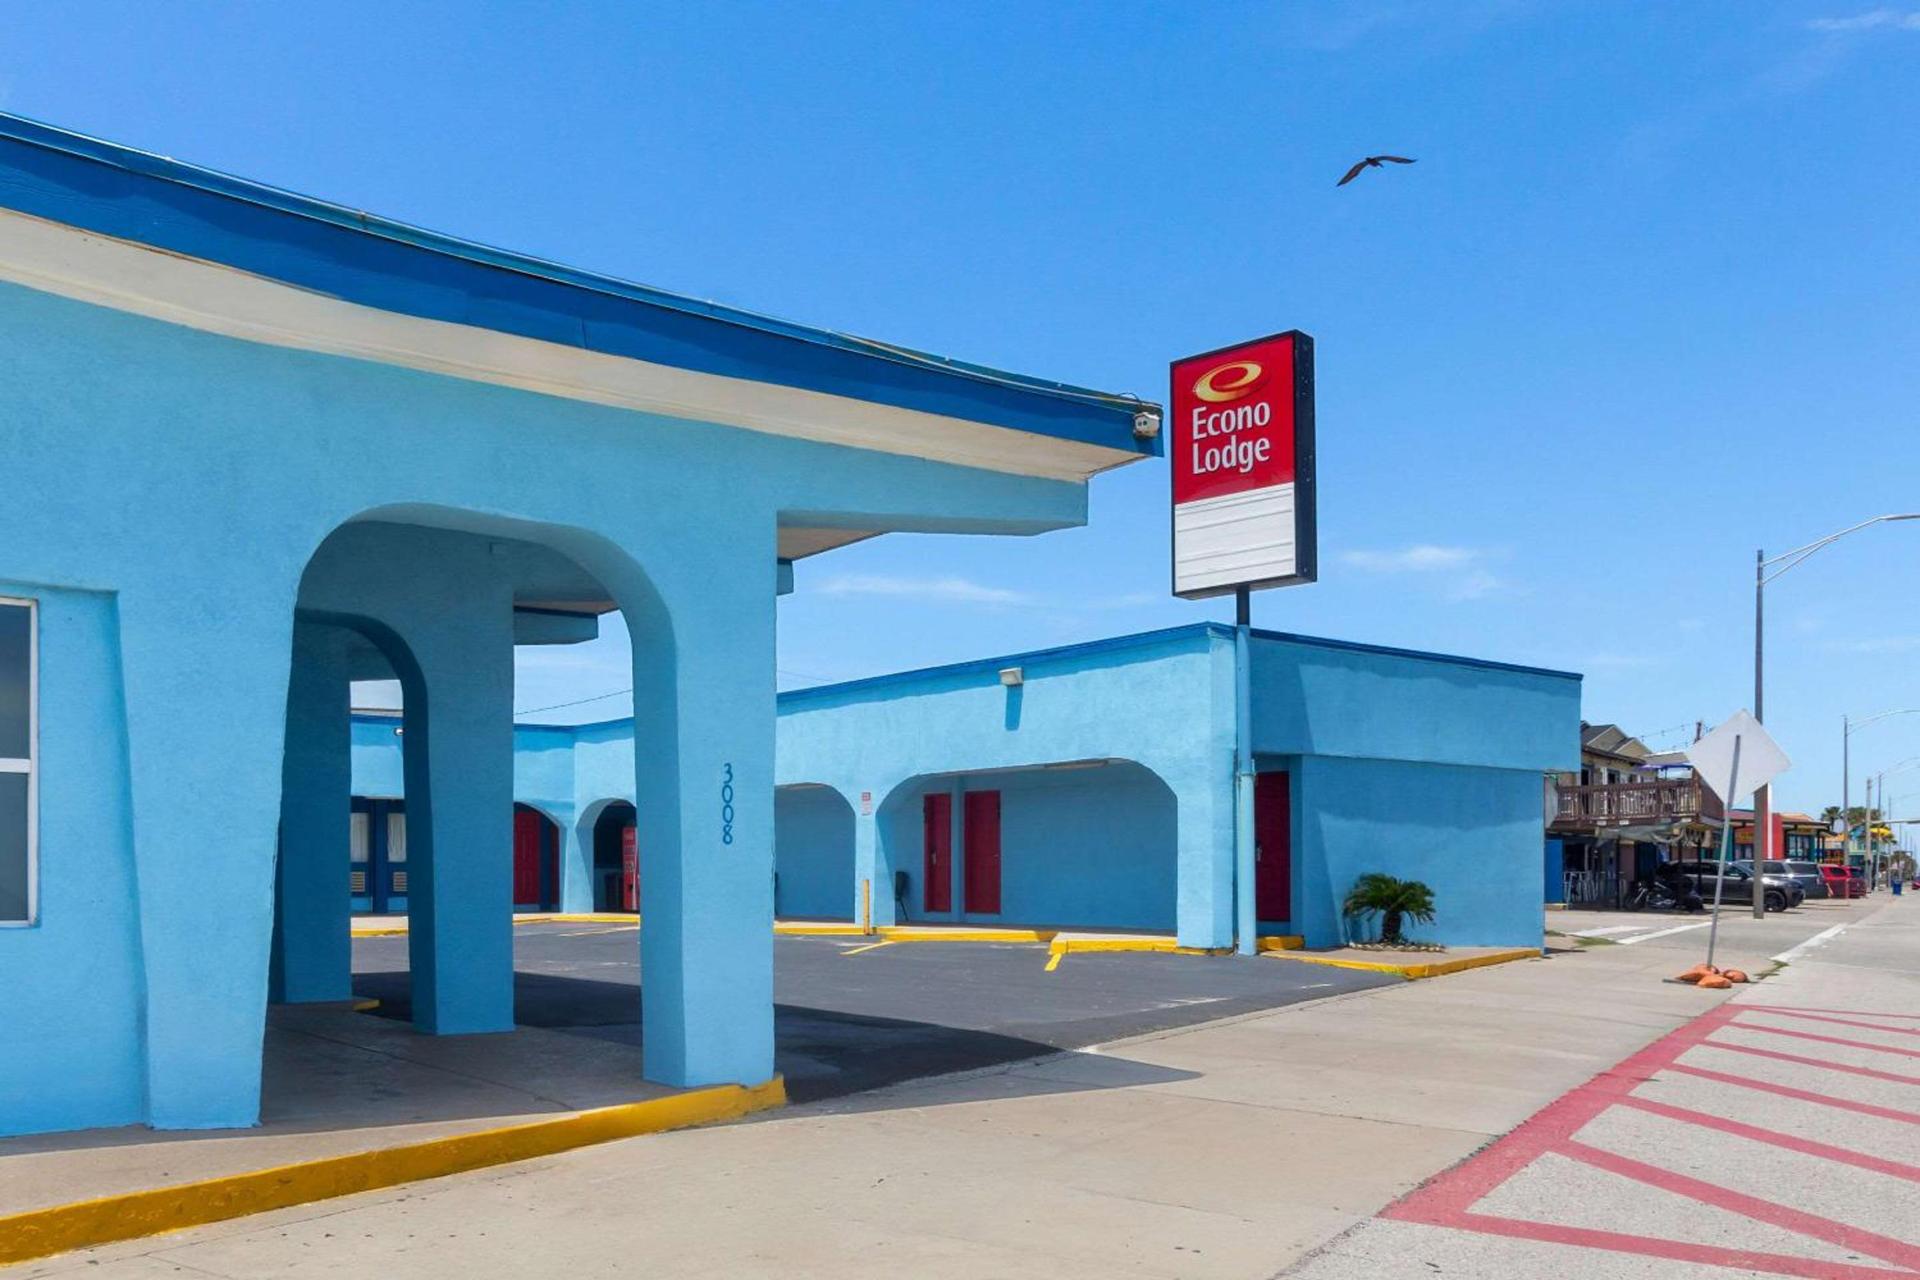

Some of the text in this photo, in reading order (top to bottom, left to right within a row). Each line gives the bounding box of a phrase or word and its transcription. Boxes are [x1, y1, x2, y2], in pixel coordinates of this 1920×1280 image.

[1192, 401, 1270, 440] Econo
[1192, 436, 1270, 474] Lodge
[721, 762, 734, 845] 3008
